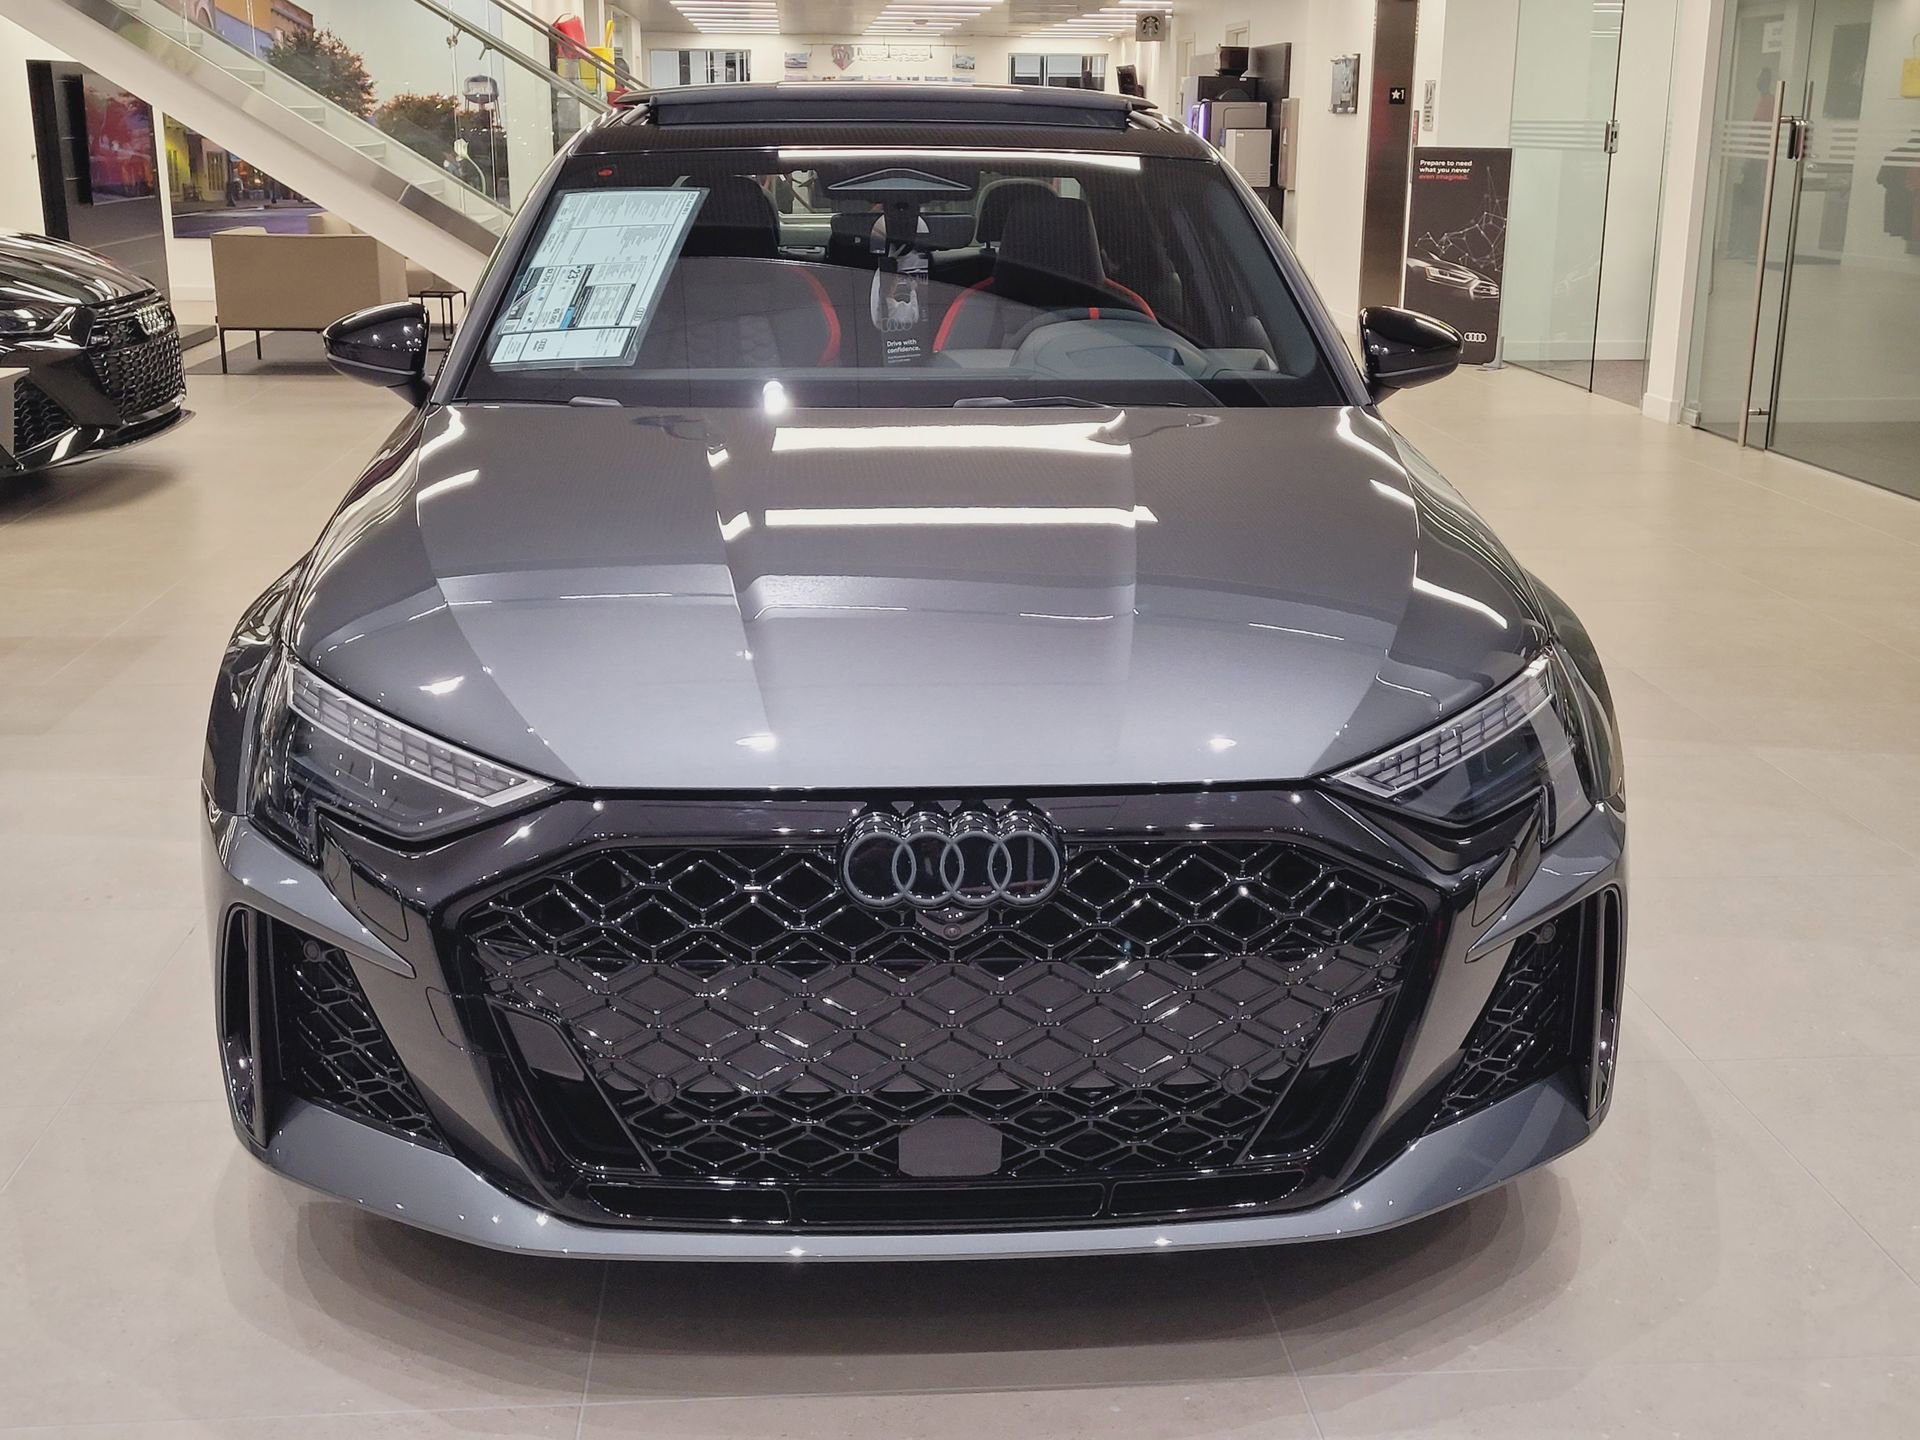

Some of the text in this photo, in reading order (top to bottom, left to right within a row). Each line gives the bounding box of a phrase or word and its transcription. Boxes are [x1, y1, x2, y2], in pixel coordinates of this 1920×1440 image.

[1400, 89, 1405, 100] 1
[1420, 159, 1446, 167] Prepare
[567, 269, 581, 280] 23
